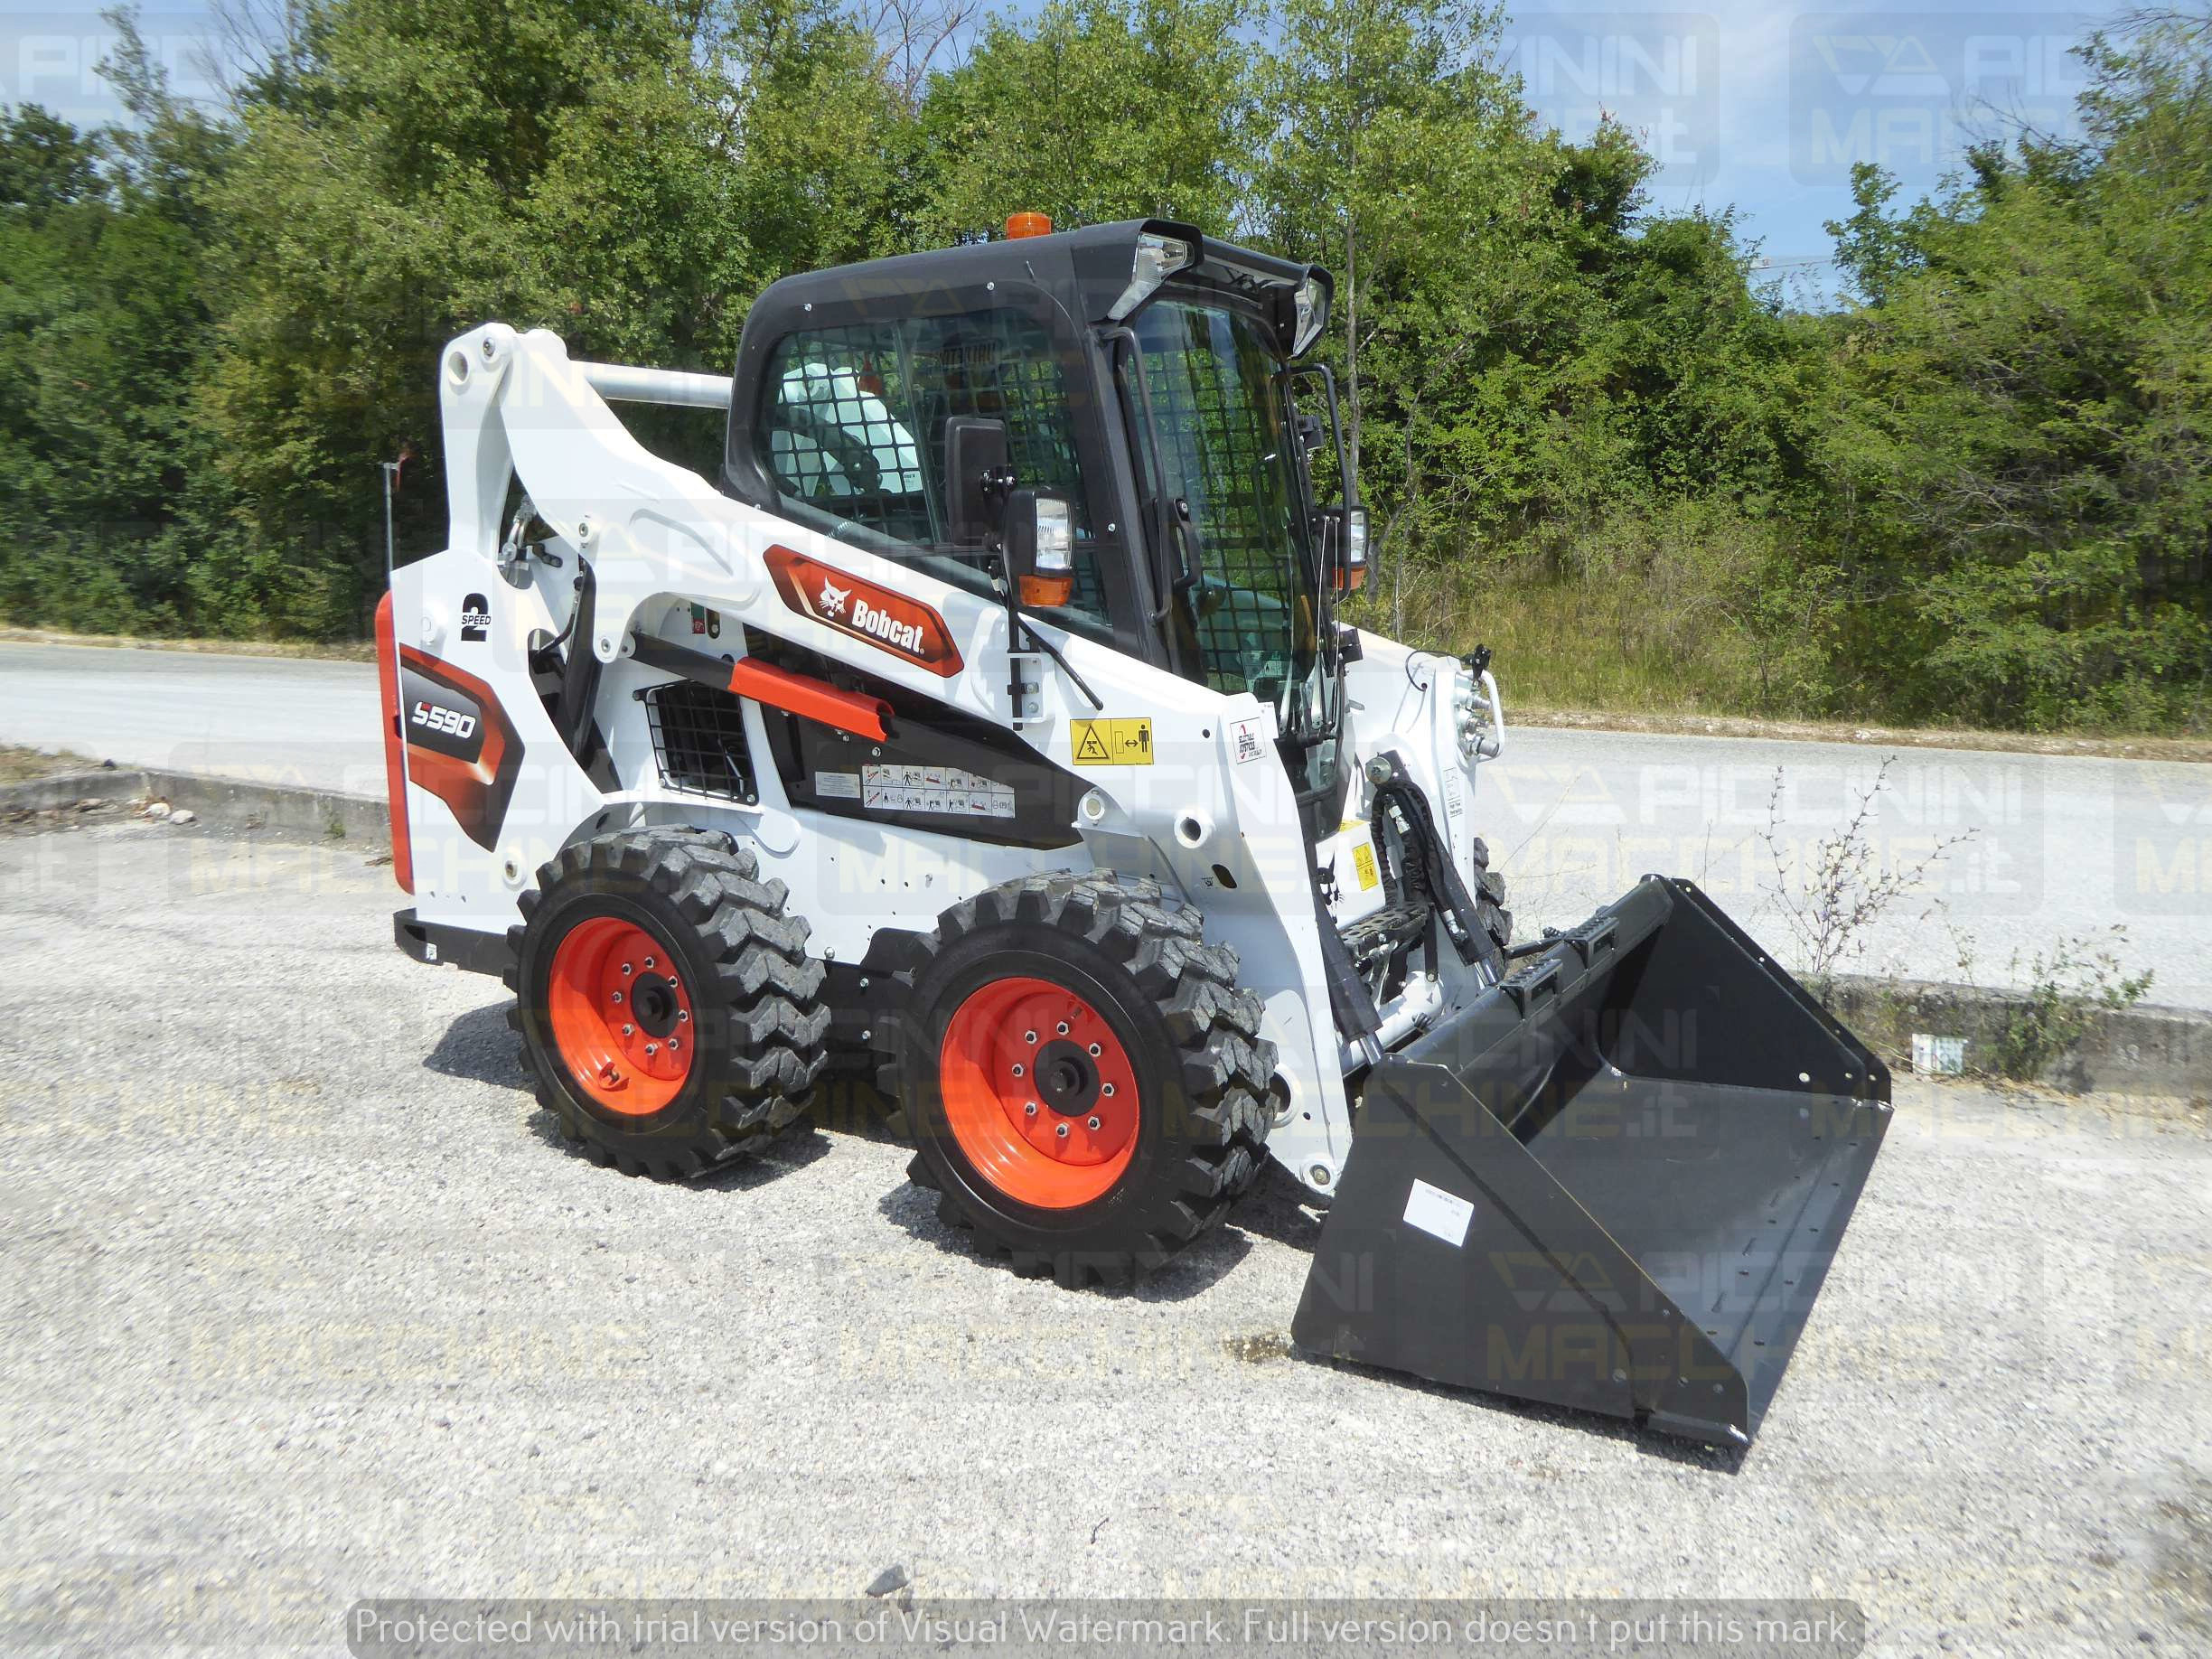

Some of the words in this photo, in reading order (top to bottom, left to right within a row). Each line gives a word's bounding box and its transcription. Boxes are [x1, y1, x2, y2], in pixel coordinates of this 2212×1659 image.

[461, 614, 492, 625] SPEED
[851, 598, 924, 653] Bobcat
[411, 701, 476, 739] S590
